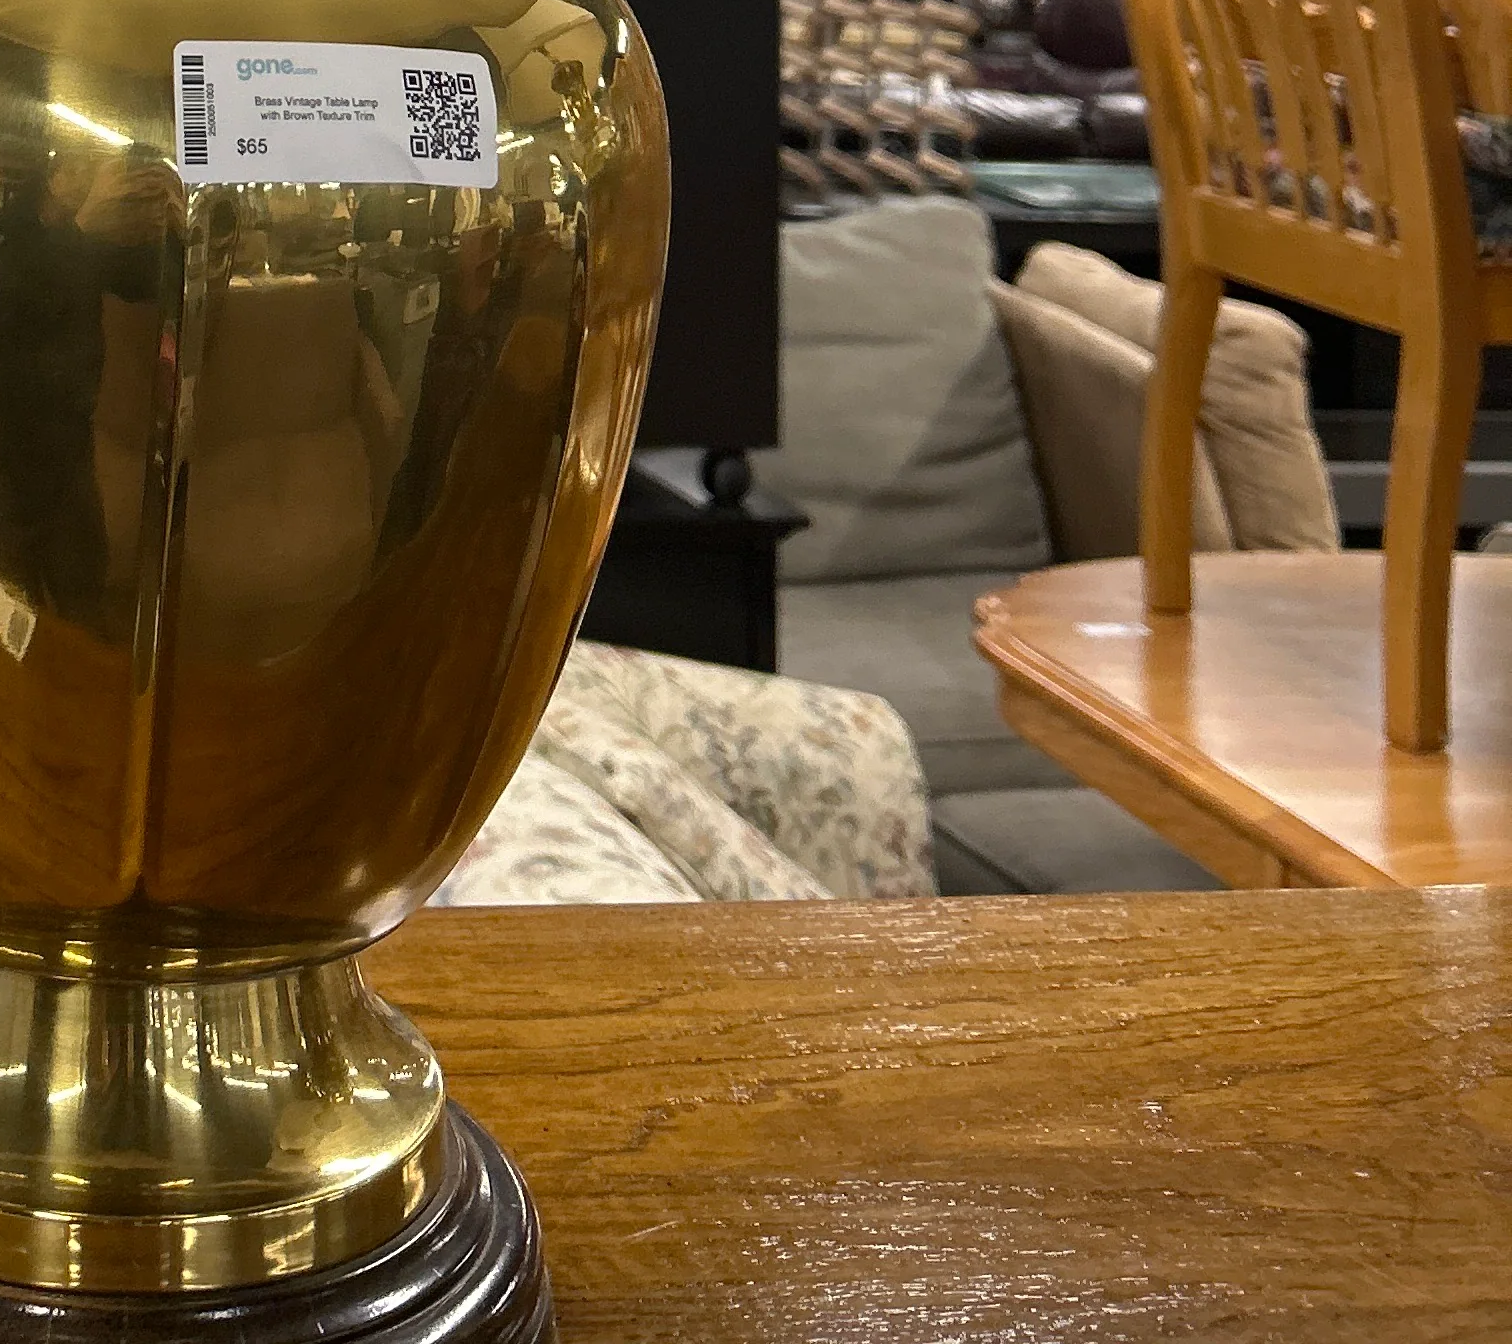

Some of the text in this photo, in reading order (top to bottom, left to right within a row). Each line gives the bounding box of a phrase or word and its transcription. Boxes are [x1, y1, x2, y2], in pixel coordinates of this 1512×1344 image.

[254, 95, 379, 109] Brass Vintage Table Lamp
[260, 110, 375, 121] with Brown Texture Trim
[236, 138, 268, 155] $65
